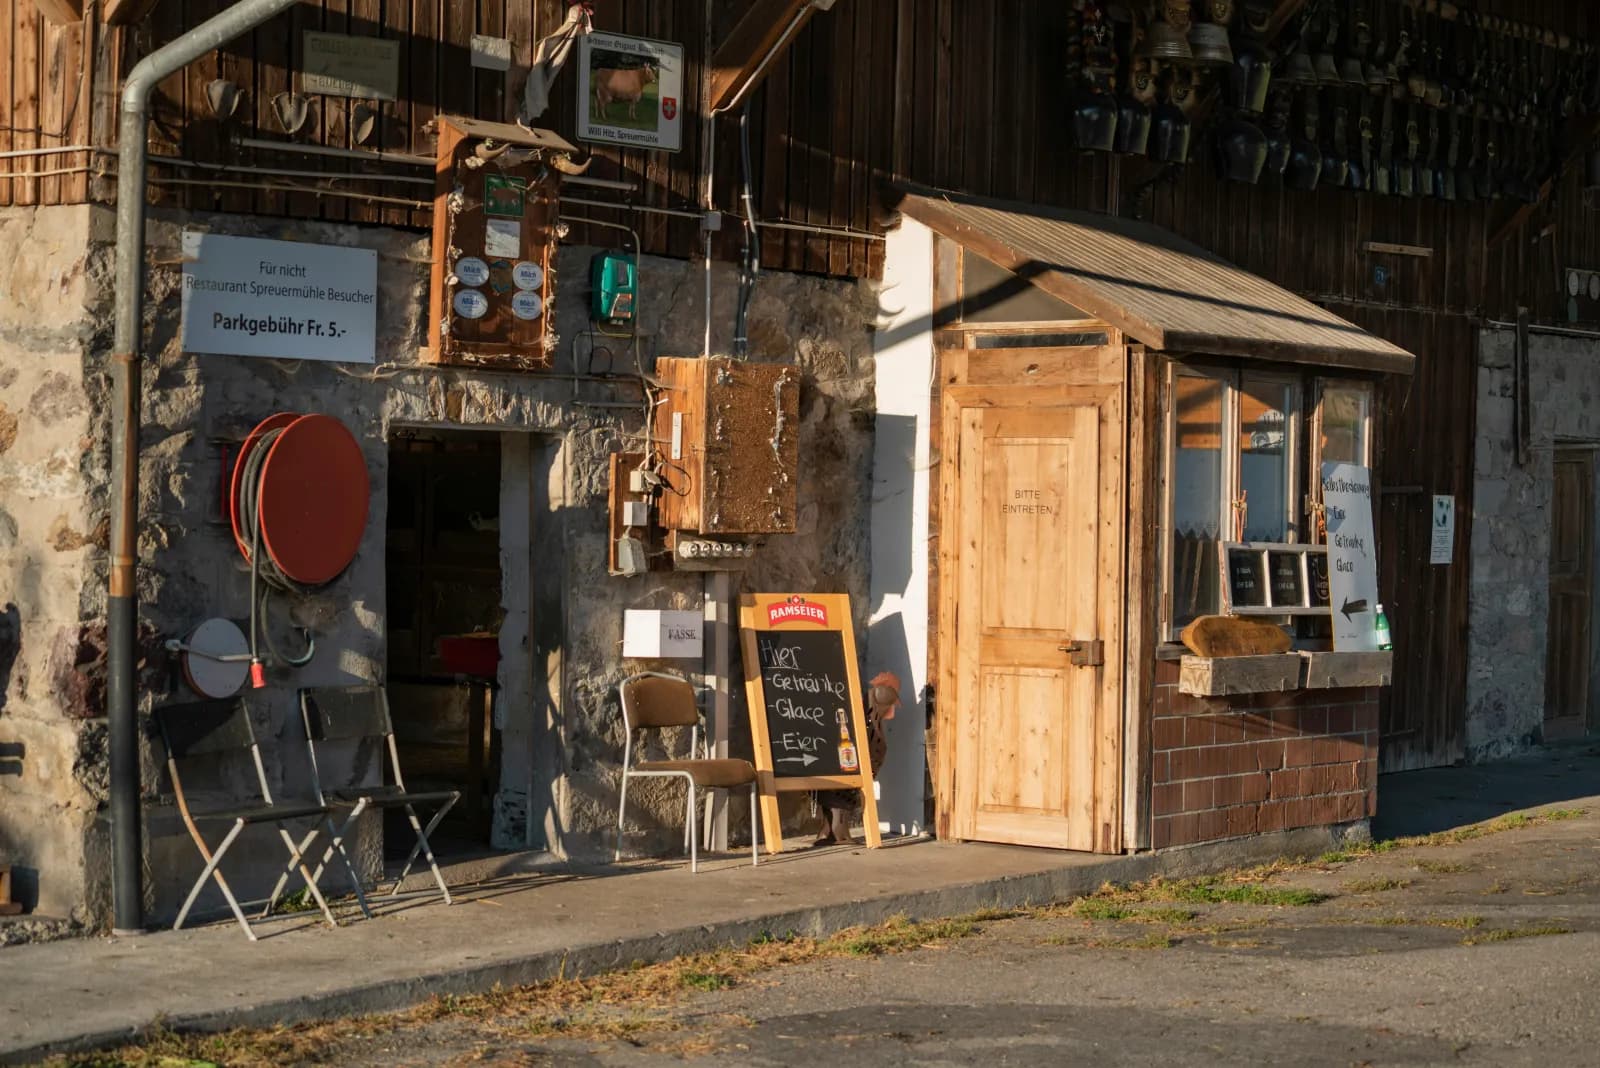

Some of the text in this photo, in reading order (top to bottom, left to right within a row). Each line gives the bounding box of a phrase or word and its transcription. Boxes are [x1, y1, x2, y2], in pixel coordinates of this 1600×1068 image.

[259, 261, 307, 278] Für nicht
[186, 275, 374, 304] Restaurant Spreuermühle Besucher
[213, 311, 347, 338] Parkgebühr Fr. 5.-
[1015, 489, 1041, 499] BITTE
[1002, 503, 1053, 515] EINTRETEN
[770, 604, 825, 621] RAMSEIER
[760, 639, 802, 669] Hier
